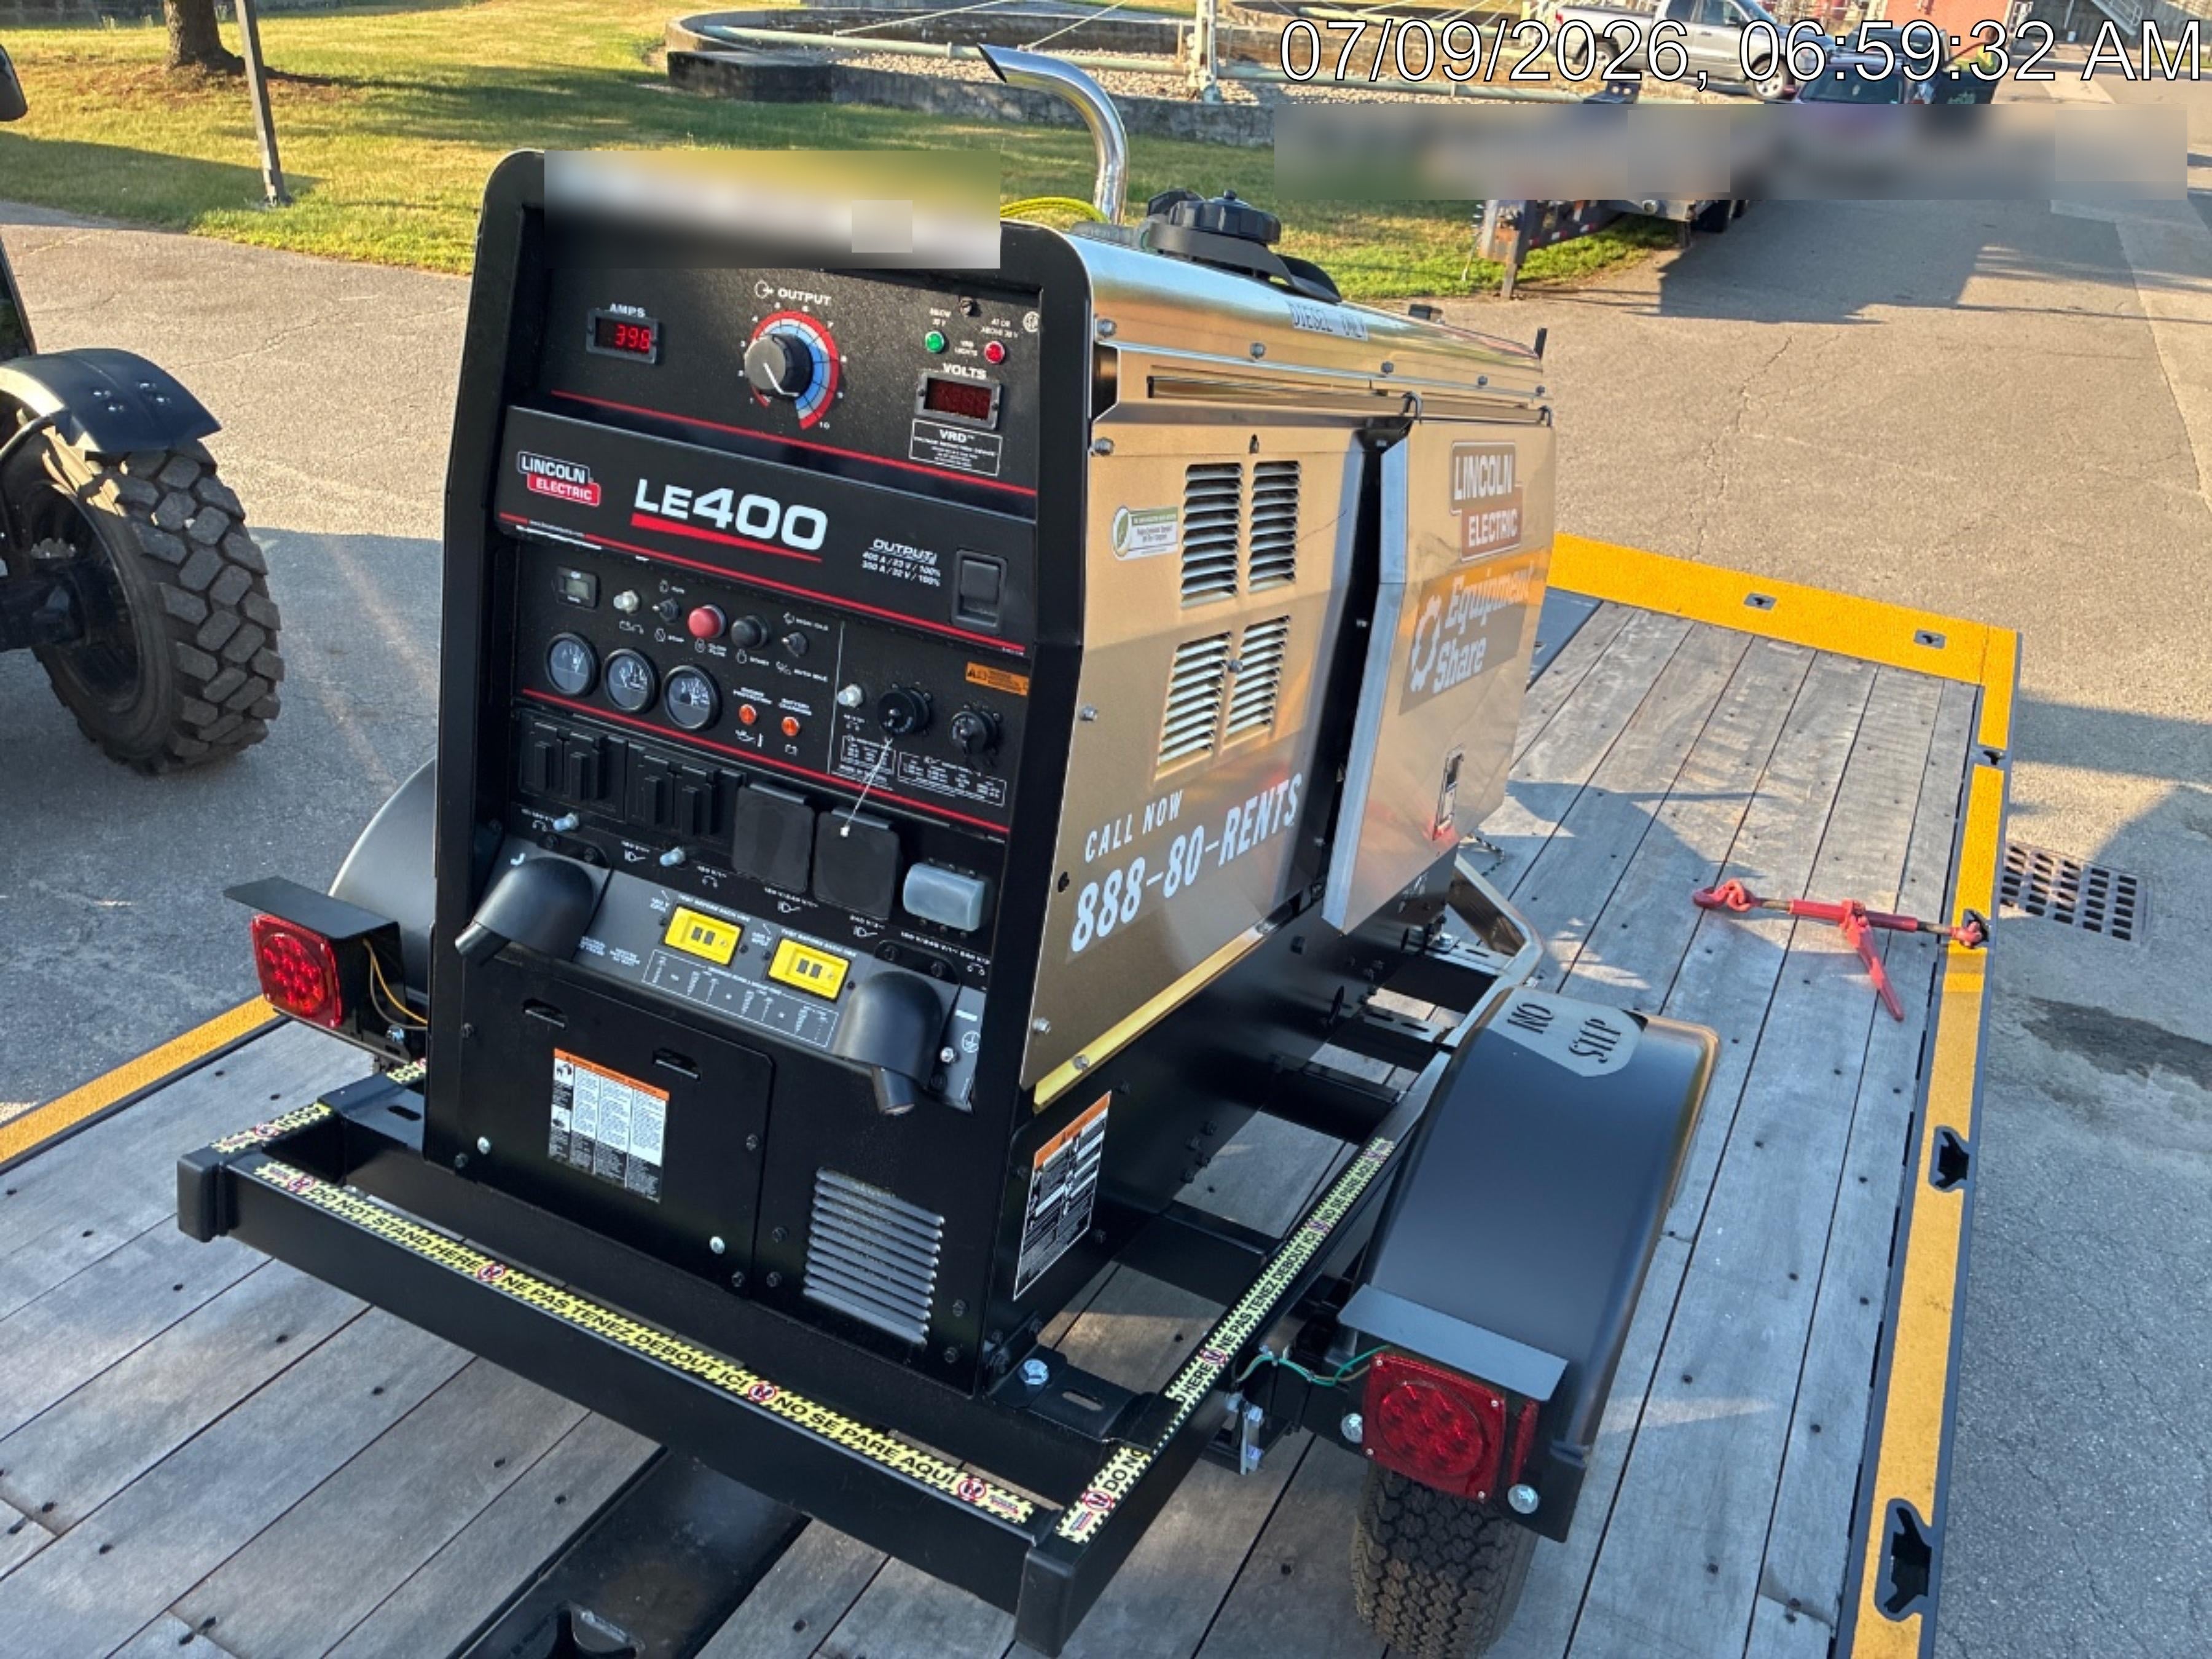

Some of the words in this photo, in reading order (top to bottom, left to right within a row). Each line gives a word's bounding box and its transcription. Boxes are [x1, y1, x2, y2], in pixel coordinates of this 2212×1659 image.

[610, 303, 646, 318] AMPS
[777, 288, 832, 306] OUTPUT
[615, 323, 651, 350] 398
[943, 363, 987, 380] VOLTS
[522, 455, 585, 484] LINCOLN
[536, 477, 592, 501] ELECTRIC
[1454, 454, 1512, 501] LINCOLN
[633, 478, 828, 551] LE400
[1469, 508, 1518, 547] ELECTRIC
[873, 538, 934, 562] OUTPUT
[1445, 560, 1535, 633] Equipment
[1433, 637, 1486, 694] Share
[1085, 814, 1133, 863] CALL
[1142, 789, 1183, 835] NOW
[1070, 773, 1303, 952] 888-80-RENTS
[1507, 1003, 1554, 1034] NO
[310, 1186, 331, 1202] DO
[335, 1196, 374, 1217] NOT
[372, 1216, 432, 1245] STAND
[431, 1242, 481, 1269] HERE
[1219, 1332, 1236, 1350] NE
[1229, 1312, 1252, 1333] PAS
[1246, 1281, 1278, 1311] TENEZ
[1272, 1243, 1308, 1281] DEBOUT
[503, 1275, 528, 1291] NE
[530, 1287, 568, 1309] PAS
[571, 1306, 637, 1336] TENEZ
[633, 1333, 717, 1373] DEBOUT
[718, 1369, 749, 1389] ICI
[1183, 1362, 1212, 1396] HERE
[775, 1396, 808, 1414] NO
[809, 1413, 838, 1430] SE
[840, 1427, 900, 1457] PARE
[1103, 1468, 1127, 1492] DO
